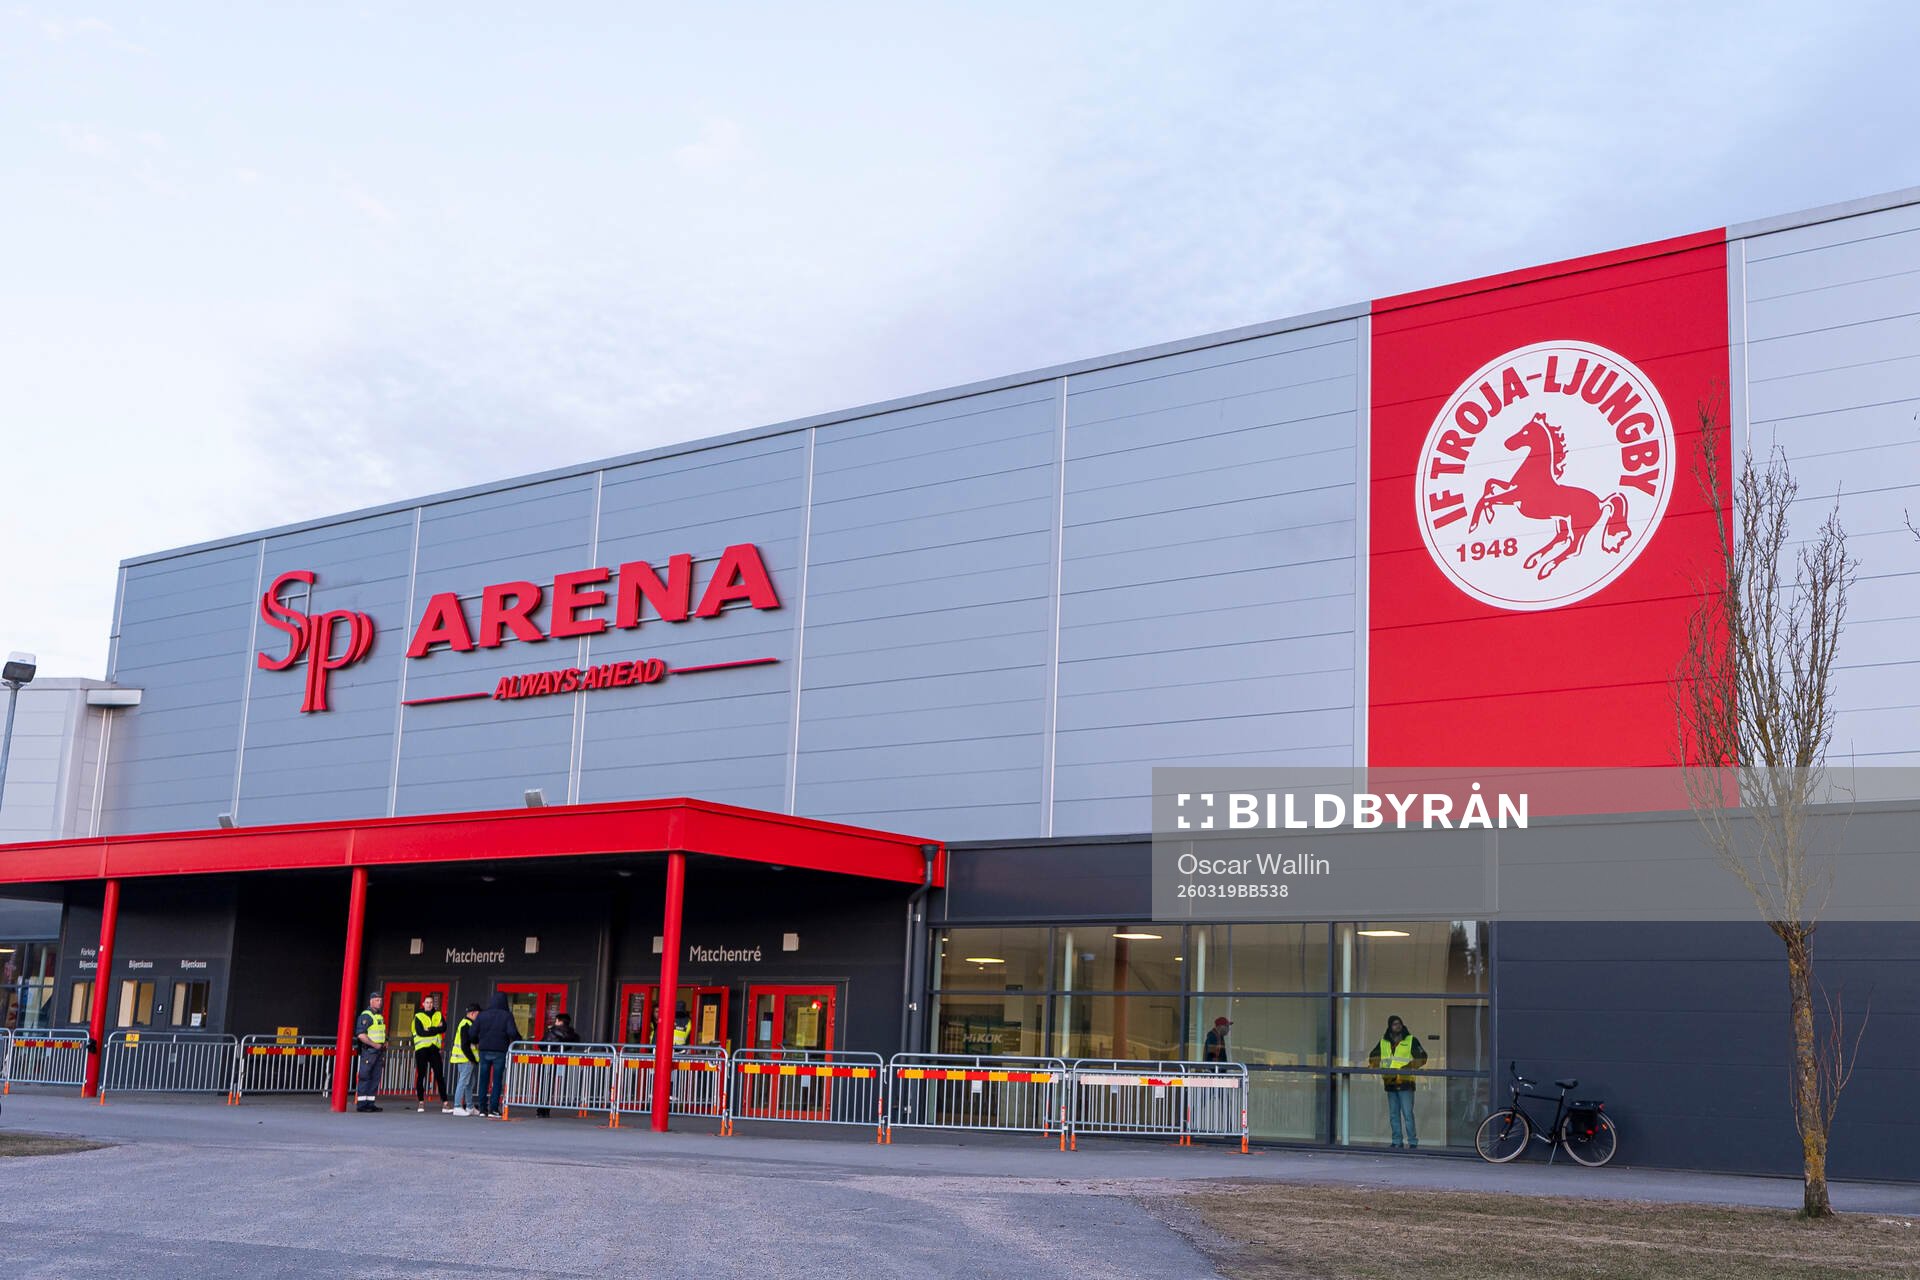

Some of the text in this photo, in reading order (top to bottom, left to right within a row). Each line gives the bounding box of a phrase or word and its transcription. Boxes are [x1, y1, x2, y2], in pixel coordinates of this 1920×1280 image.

[1429, 355, 1661, 530] IF TROJA-LJUNGBY
[1456, 537, 1519, 563] 1948
[406, 543, 781, 658] ARENA
[492, 658, 667, 701] ALWAYS AHEAD
[445, 948, 505, 964] Matchentré
[688, 945, 762, 962] Matchentré
